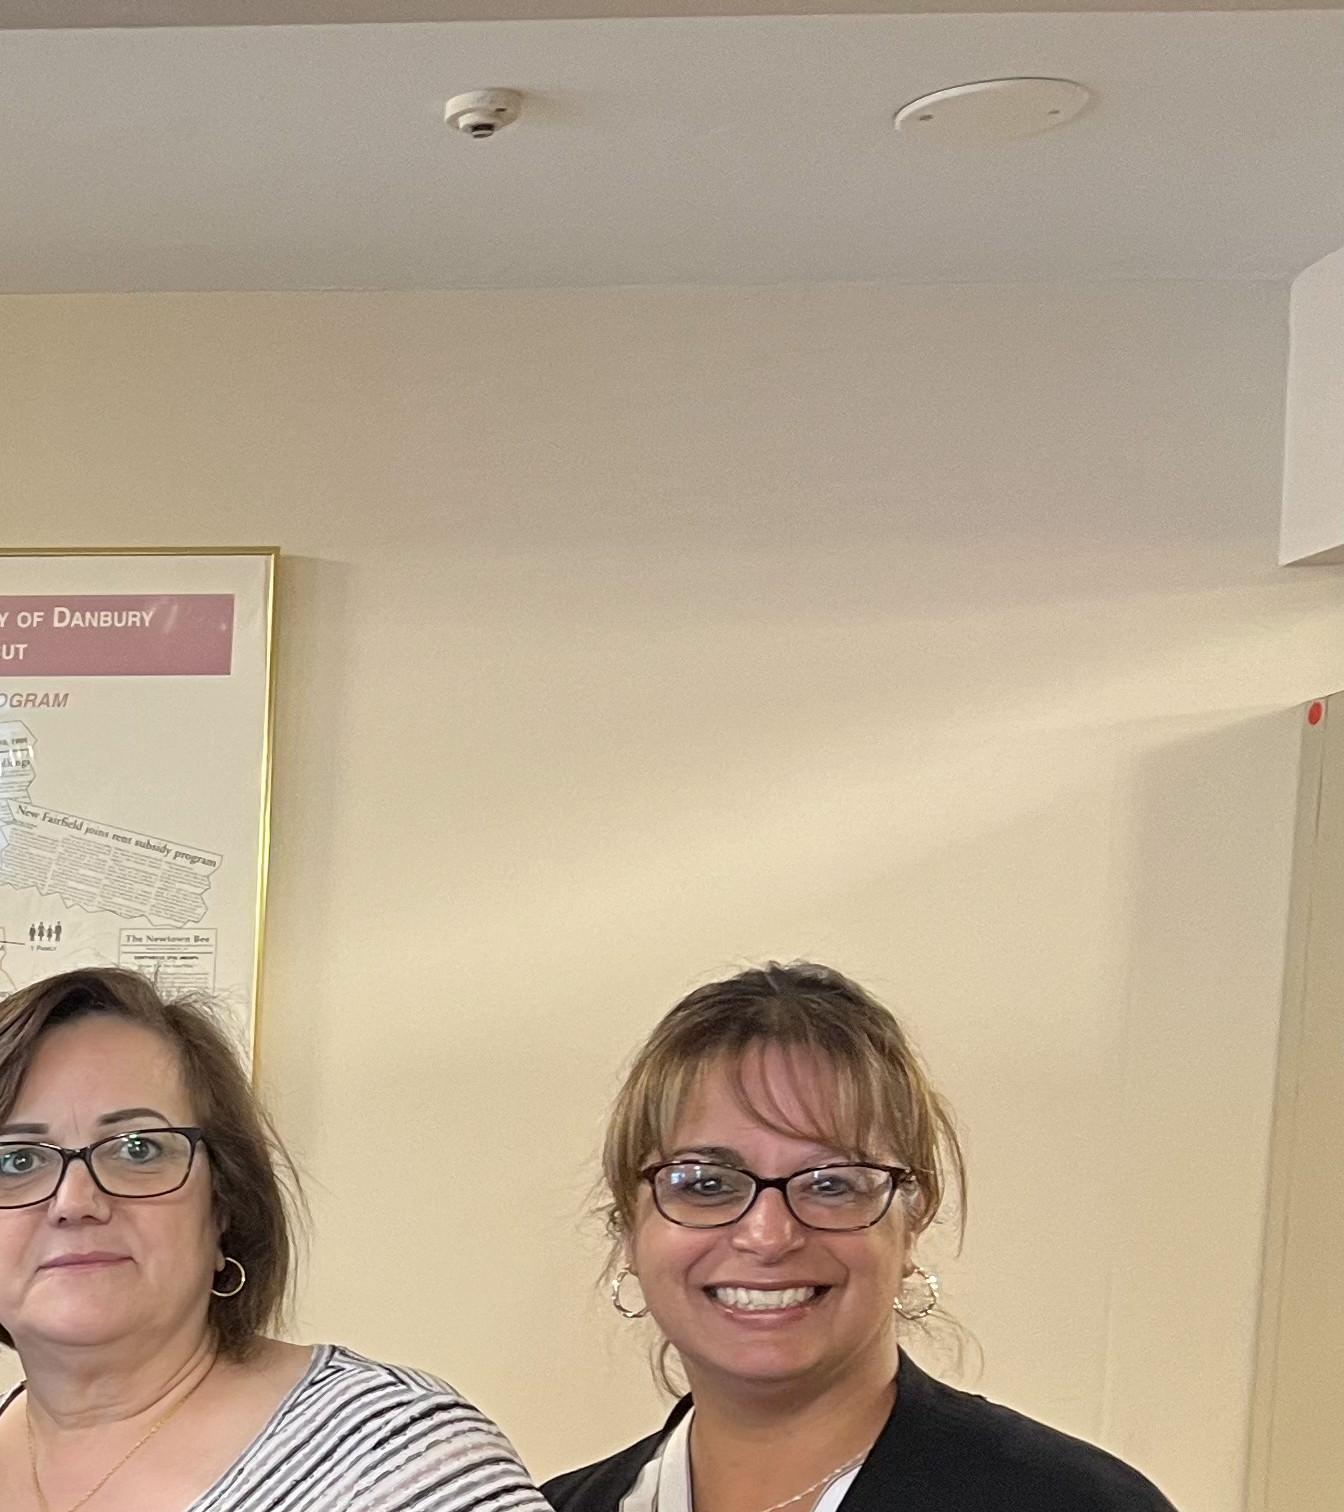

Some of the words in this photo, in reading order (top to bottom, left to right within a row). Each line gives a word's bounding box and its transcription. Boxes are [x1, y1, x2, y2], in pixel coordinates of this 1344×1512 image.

[16, 611, 44, 628] OF
[53, 607, 154, 628] DANBURY
[17, 805, 40, 818] New
[42, 811, 84, 832] Fairfield
[84, 825, 109, 840] joins
[111, 832, 132, 845] rent
[134, 838, 172, 858] subsidy
[172, 849, 216, 868] program
[126, 934, 143, 943] The
[146, 935, 190, 943] Newtown
